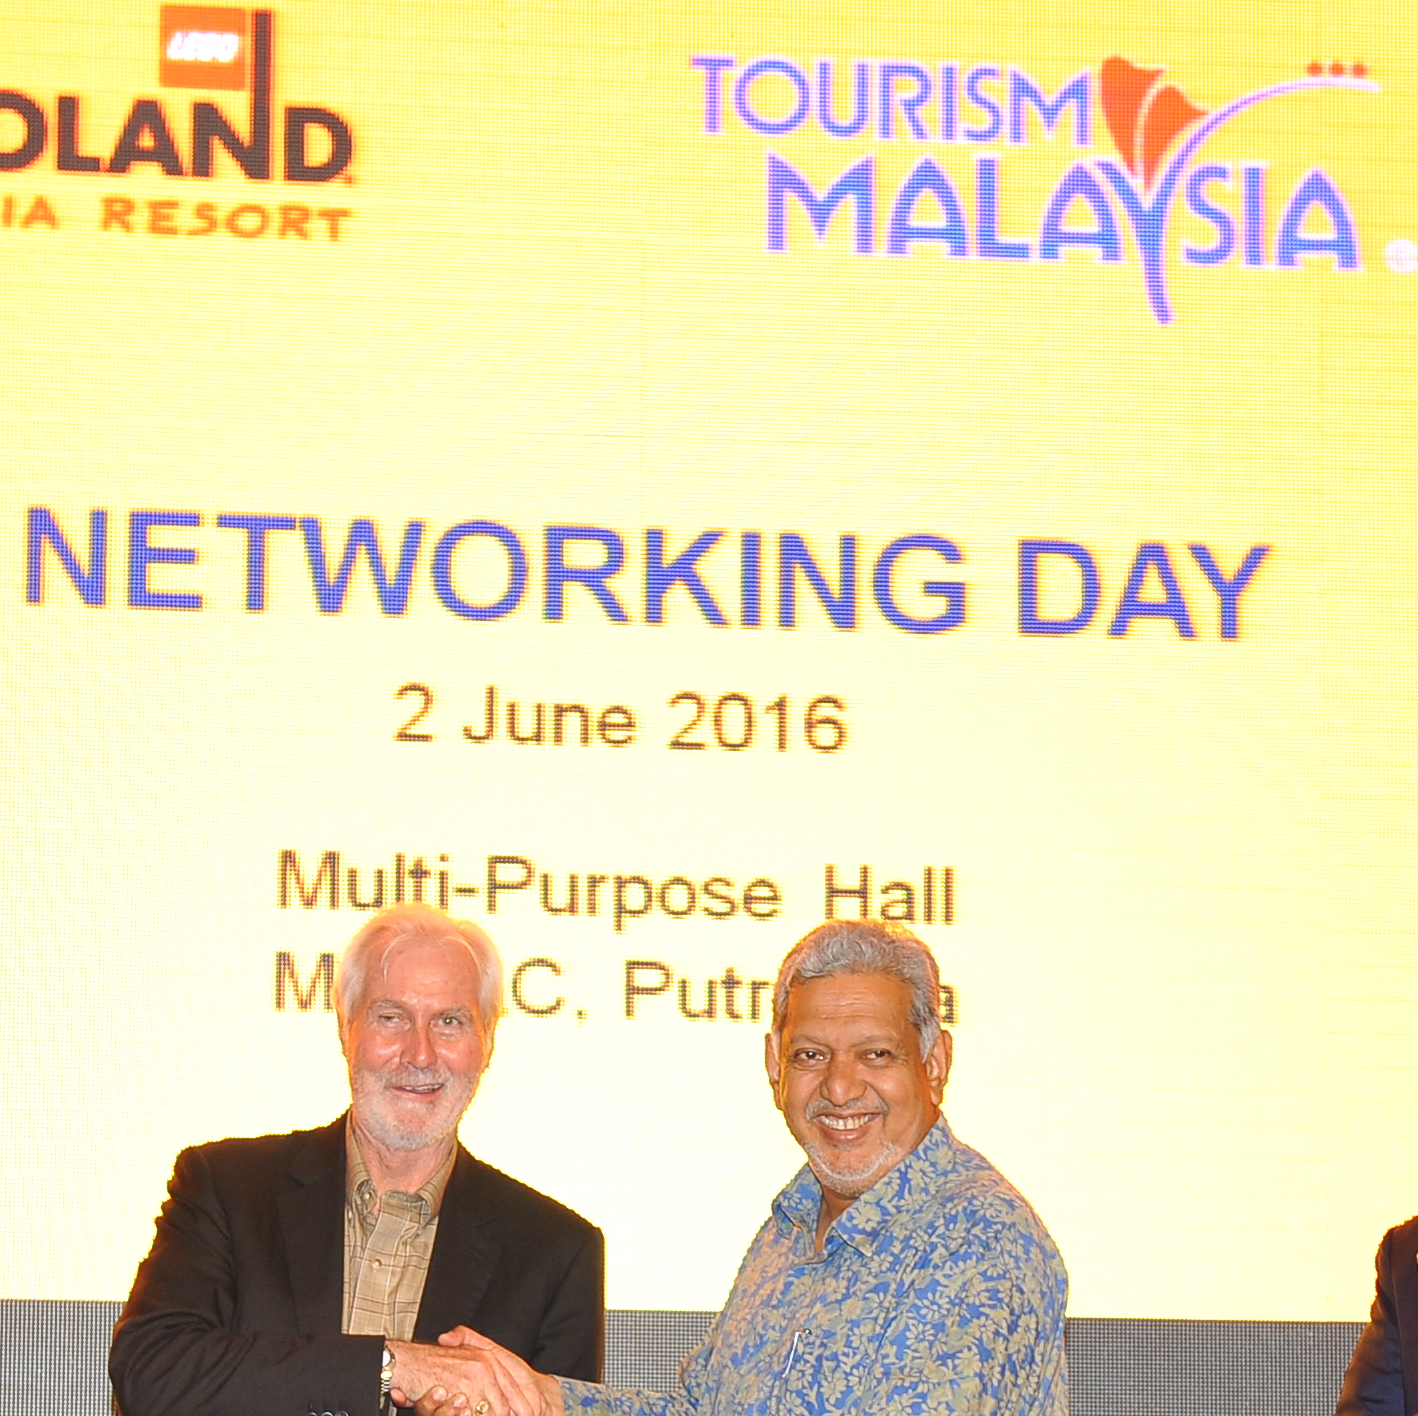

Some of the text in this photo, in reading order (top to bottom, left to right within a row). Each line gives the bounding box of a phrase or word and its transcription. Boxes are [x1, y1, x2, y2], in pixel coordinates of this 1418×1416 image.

[691, 56, 1094, 147] TOURISM
[100, 197, 353, 242] RESORT
[766, 152, 1361, 325] MALAYSIA
[25, 507, 1272, 641] NETWORKING DAY
[396, 683, 847, 754] 2 June 2016
[277, 849, 954, 934] Multi-Purpose Hall
